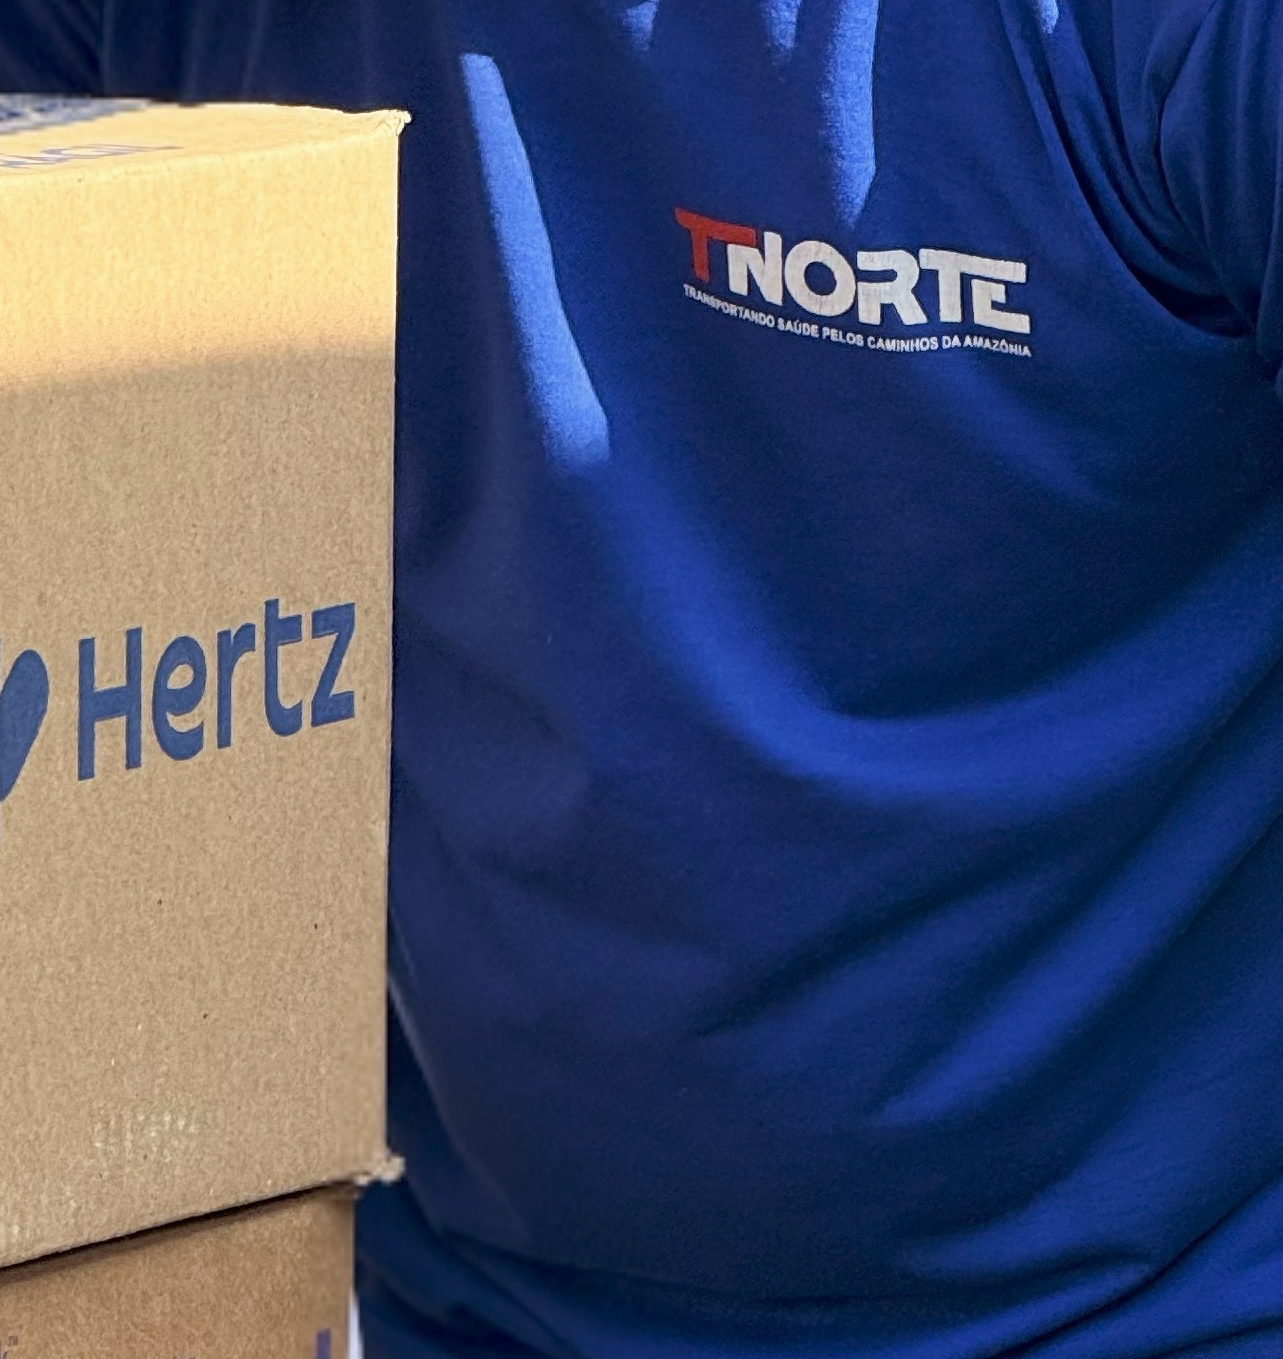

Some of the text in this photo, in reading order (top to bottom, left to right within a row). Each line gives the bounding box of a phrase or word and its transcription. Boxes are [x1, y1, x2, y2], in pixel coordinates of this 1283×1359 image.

[683, 283, 1032, 358] TRANSPORTANDO SAÚDE PELOS CAMINHOS DA AMAZÔNIA
[77, 598, 355, 781] Hertz
